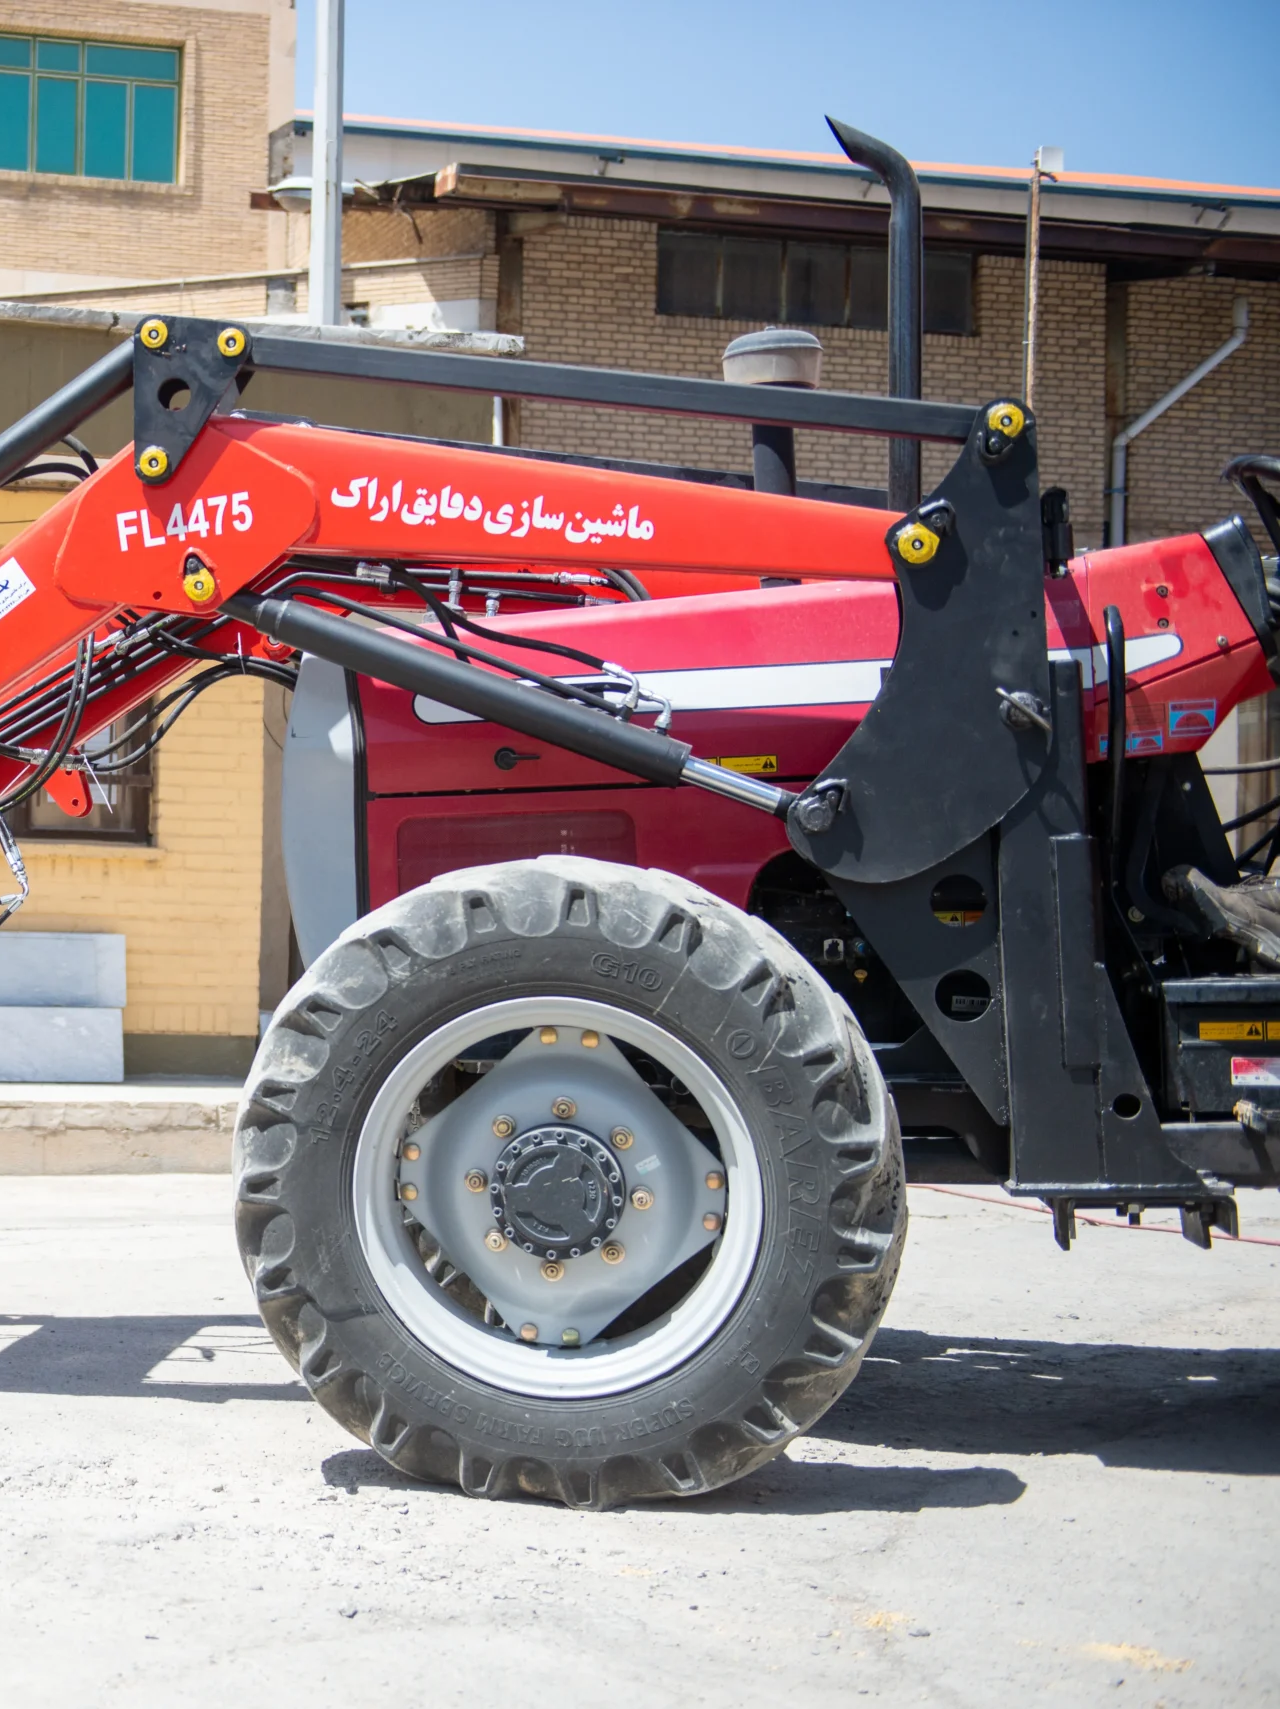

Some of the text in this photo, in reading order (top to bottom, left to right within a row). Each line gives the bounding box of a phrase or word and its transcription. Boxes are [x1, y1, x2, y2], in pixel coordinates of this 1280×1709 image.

[330, 476, 403, 522] اراک
[483, 495, 564, 538] سازی
[116, 491, 253, 552] FL4475
[565, 504, 654, 544] ماشین
[481, 948, 522, 965] RATING
[591, 951, 663, 993] G10
[308, 1009, 398, 1145] 12.4-24
[376, 1351, 695, 1448] SUPER LUG FARM SERVICE
